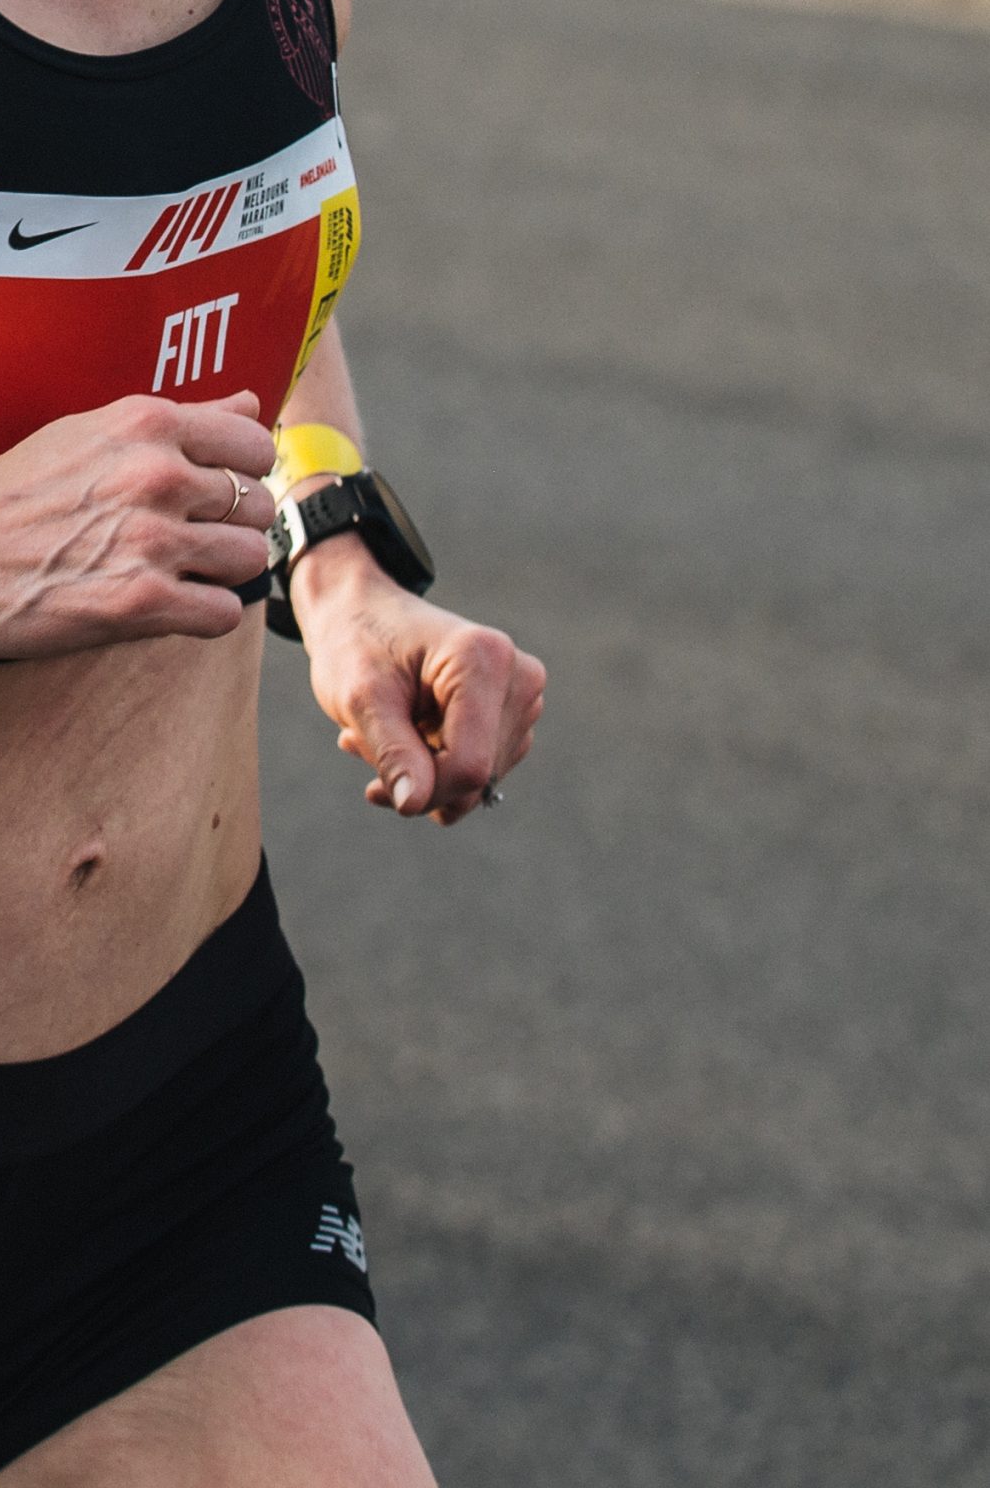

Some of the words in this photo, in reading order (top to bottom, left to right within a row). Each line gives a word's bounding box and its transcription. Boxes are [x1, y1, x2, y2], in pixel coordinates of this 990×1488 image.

[243, 178, 289, 210] MELBOURNE
[246, 172, 265, 192] NIKE
[241, 199, 285, 228] MARATHON
[152, 293, 239, 393] FITT
